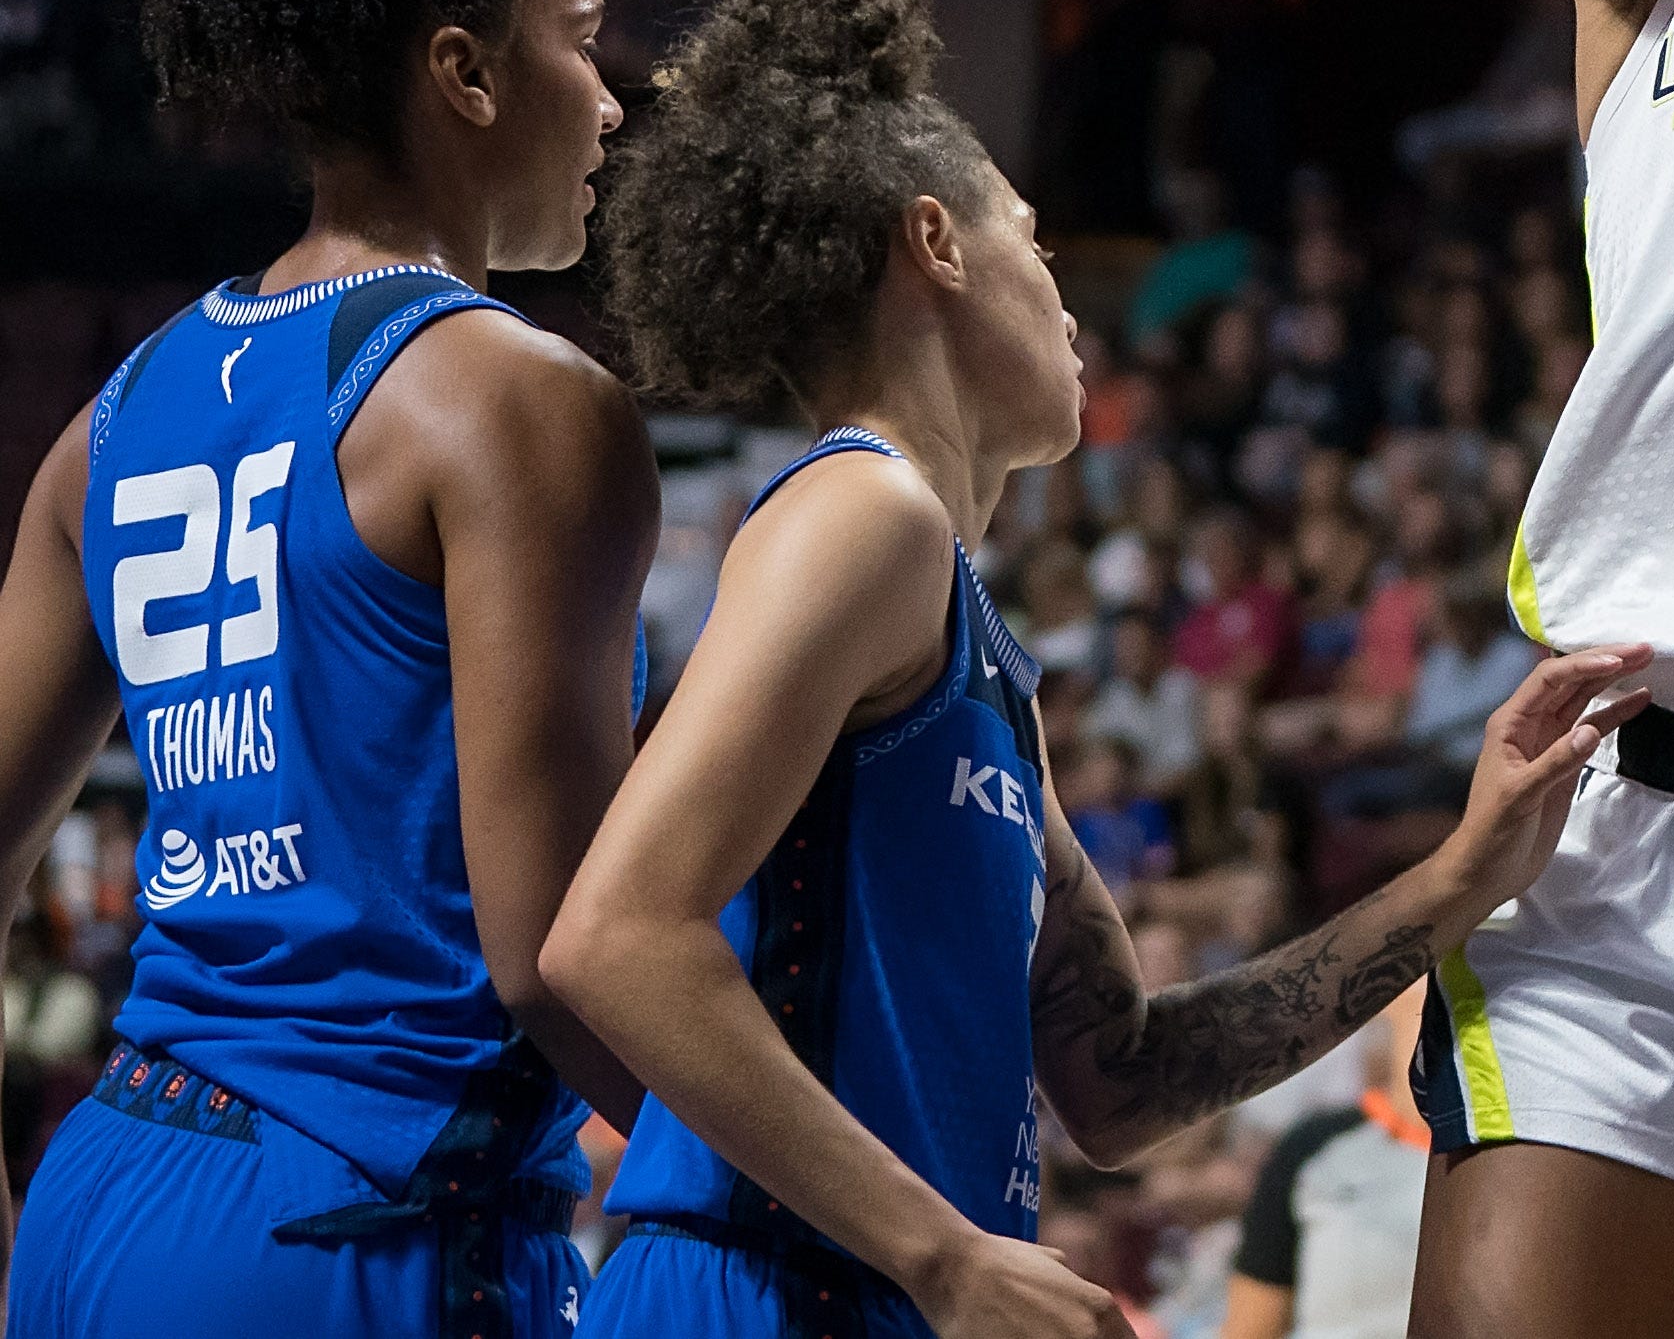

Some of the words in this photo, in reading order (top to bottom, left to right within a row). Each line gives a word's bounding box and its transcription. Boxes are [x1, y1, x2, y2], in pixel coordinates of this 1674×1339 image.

[113, 440, 295, 686] 25
[146, 685, 276, 793] THOMAS
[207, 823, 304, 898] AT&T
